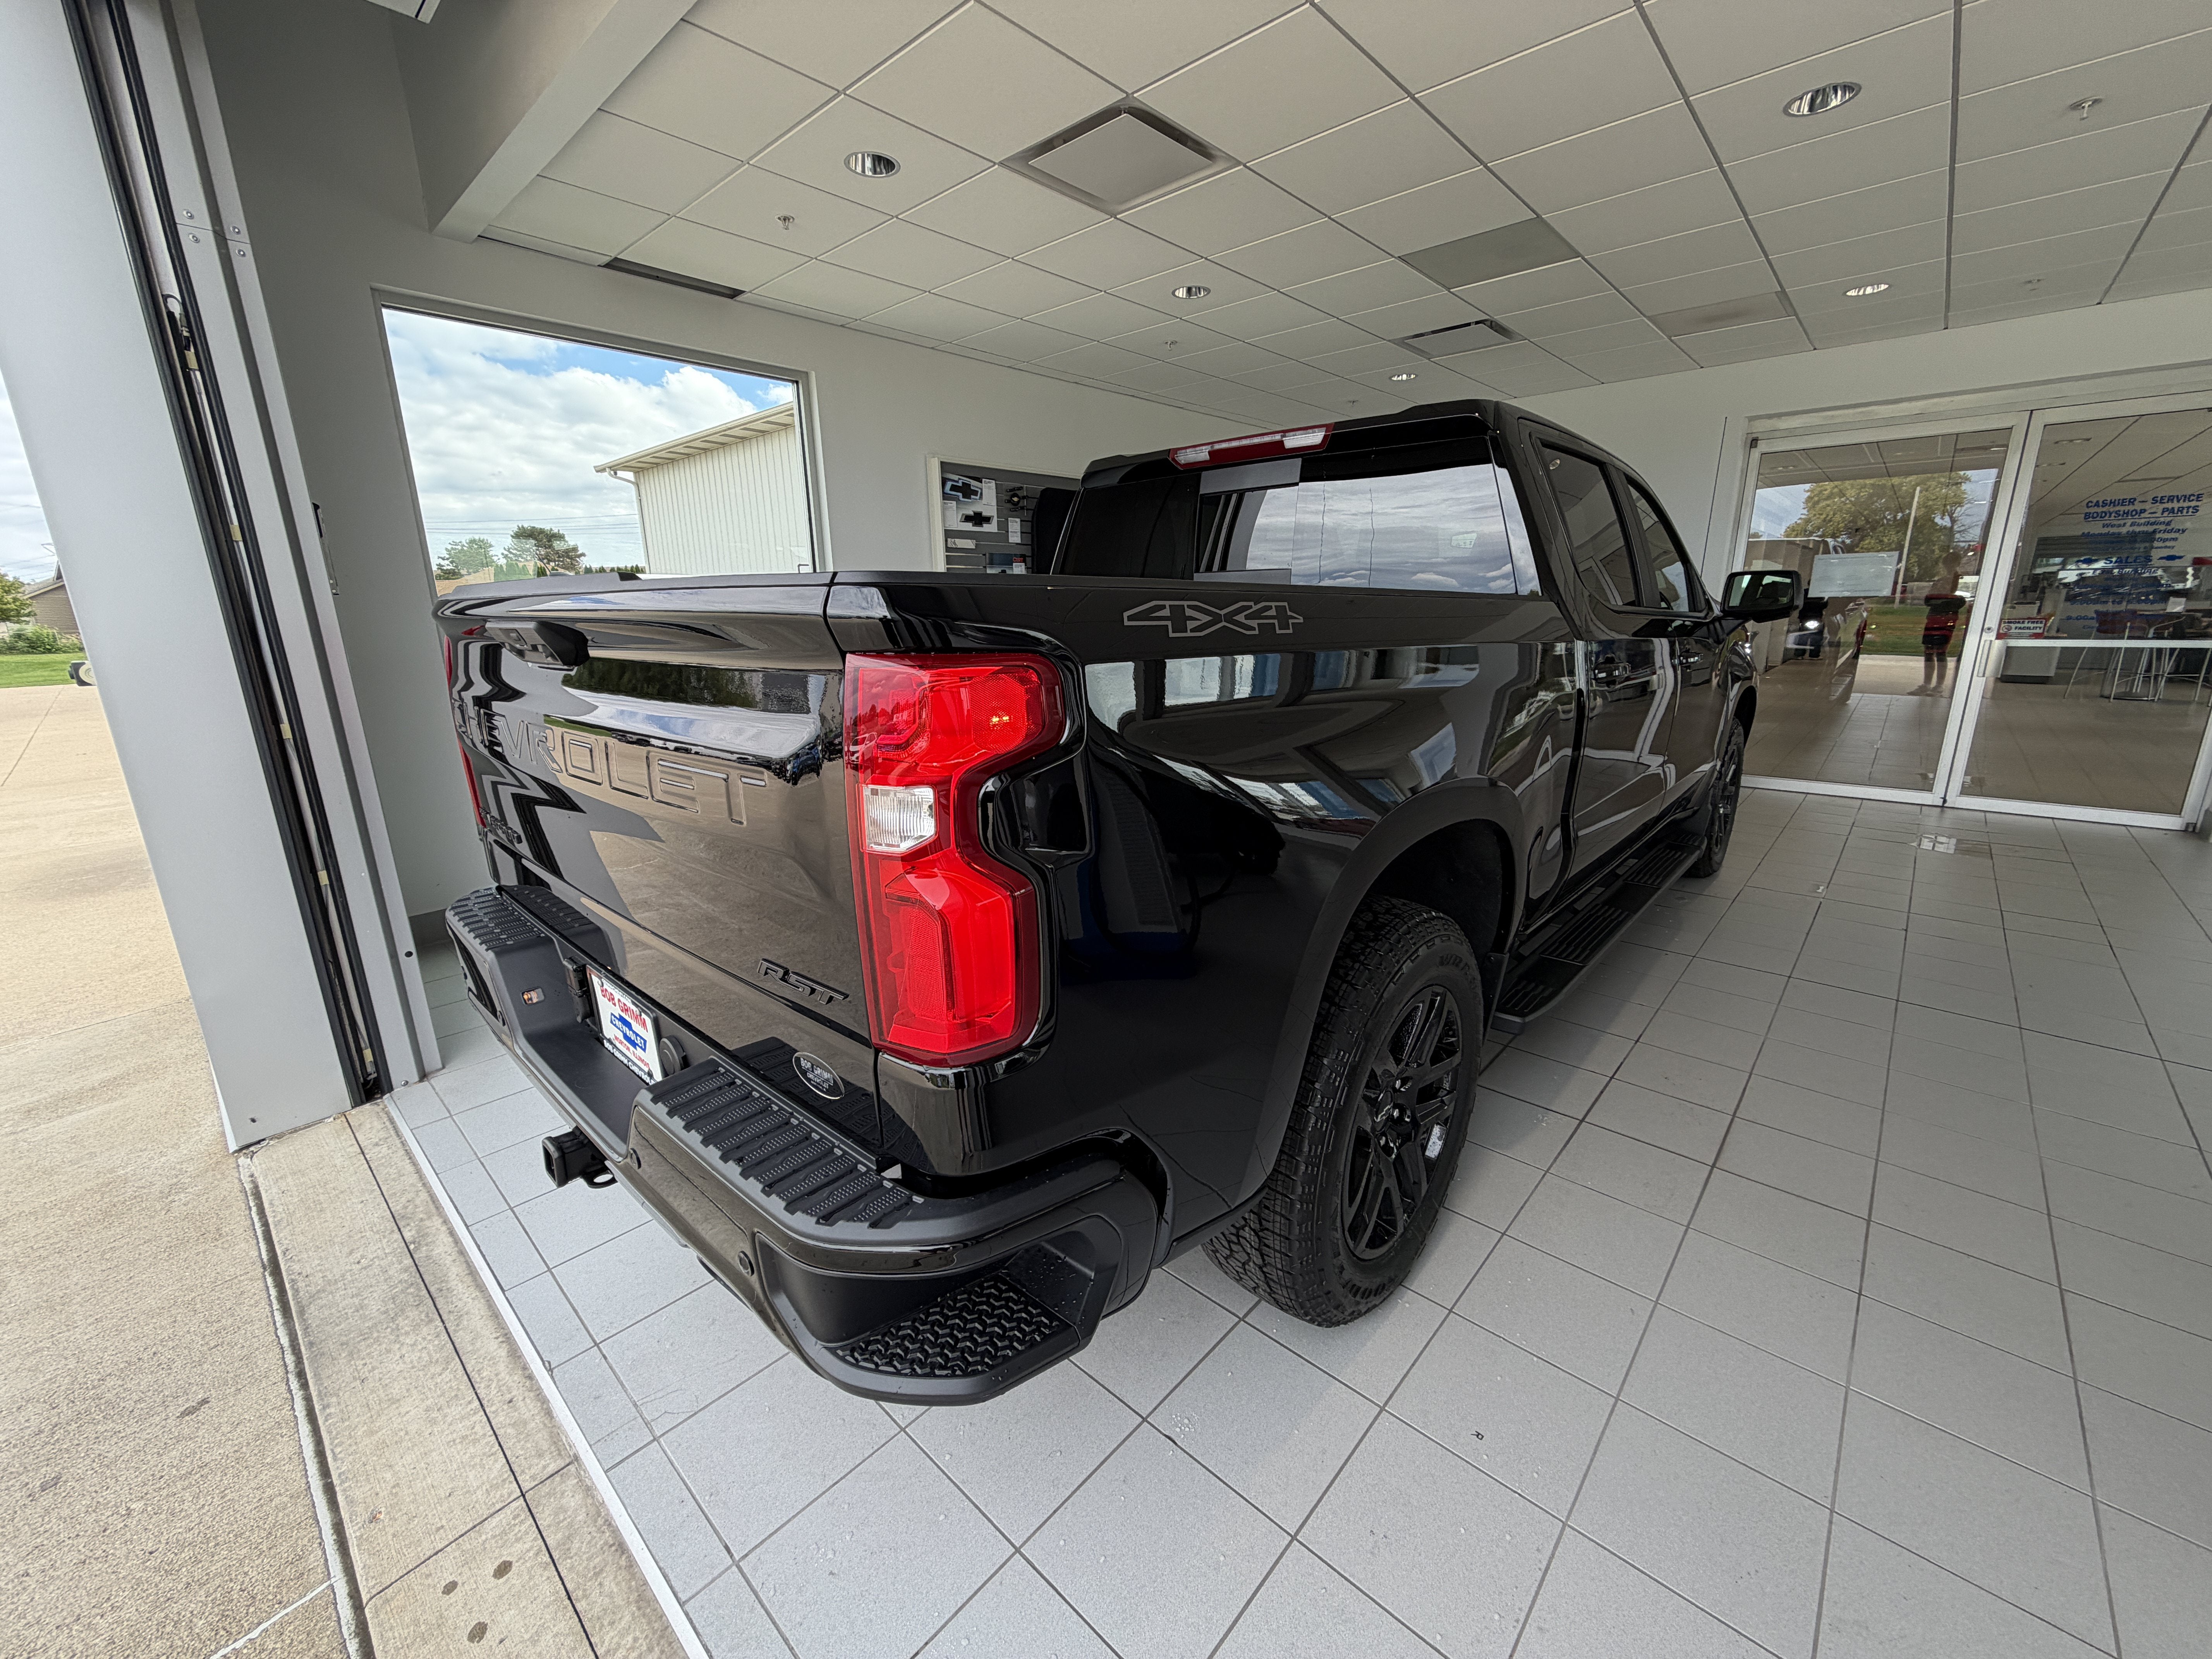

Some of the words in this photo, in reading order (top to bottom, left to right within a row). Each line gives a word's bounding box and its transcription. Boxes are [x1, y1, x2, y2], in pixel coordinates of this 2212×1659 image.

[2083, 508, 2147, 520] BODYSHOP
[2161, 505, 2200, 516] PARTS
[2086, 497, 2137, 509] CASHIER
[2150, 493, 2205, 505] SERVICE
[2152, 527, 2188, 535] Friday
[2104, 555, 2153, 565] SALES
[450, 696, 768, 826] CHEVROLET
[757, 958, 850, 1005] RST
[599, 986, 617, 1007] BOB
[617, 998, 648, 1033] GRIMM
[611, 1015, 645, 1049] CHEVROLET
[603, 1039, 613, 1054] BOB
[628, 1061, 658, 1087] CHEVROLE
[800, 1057, 812, 1071] BOB
[813, 1065, 834, 1084] GRIMM
